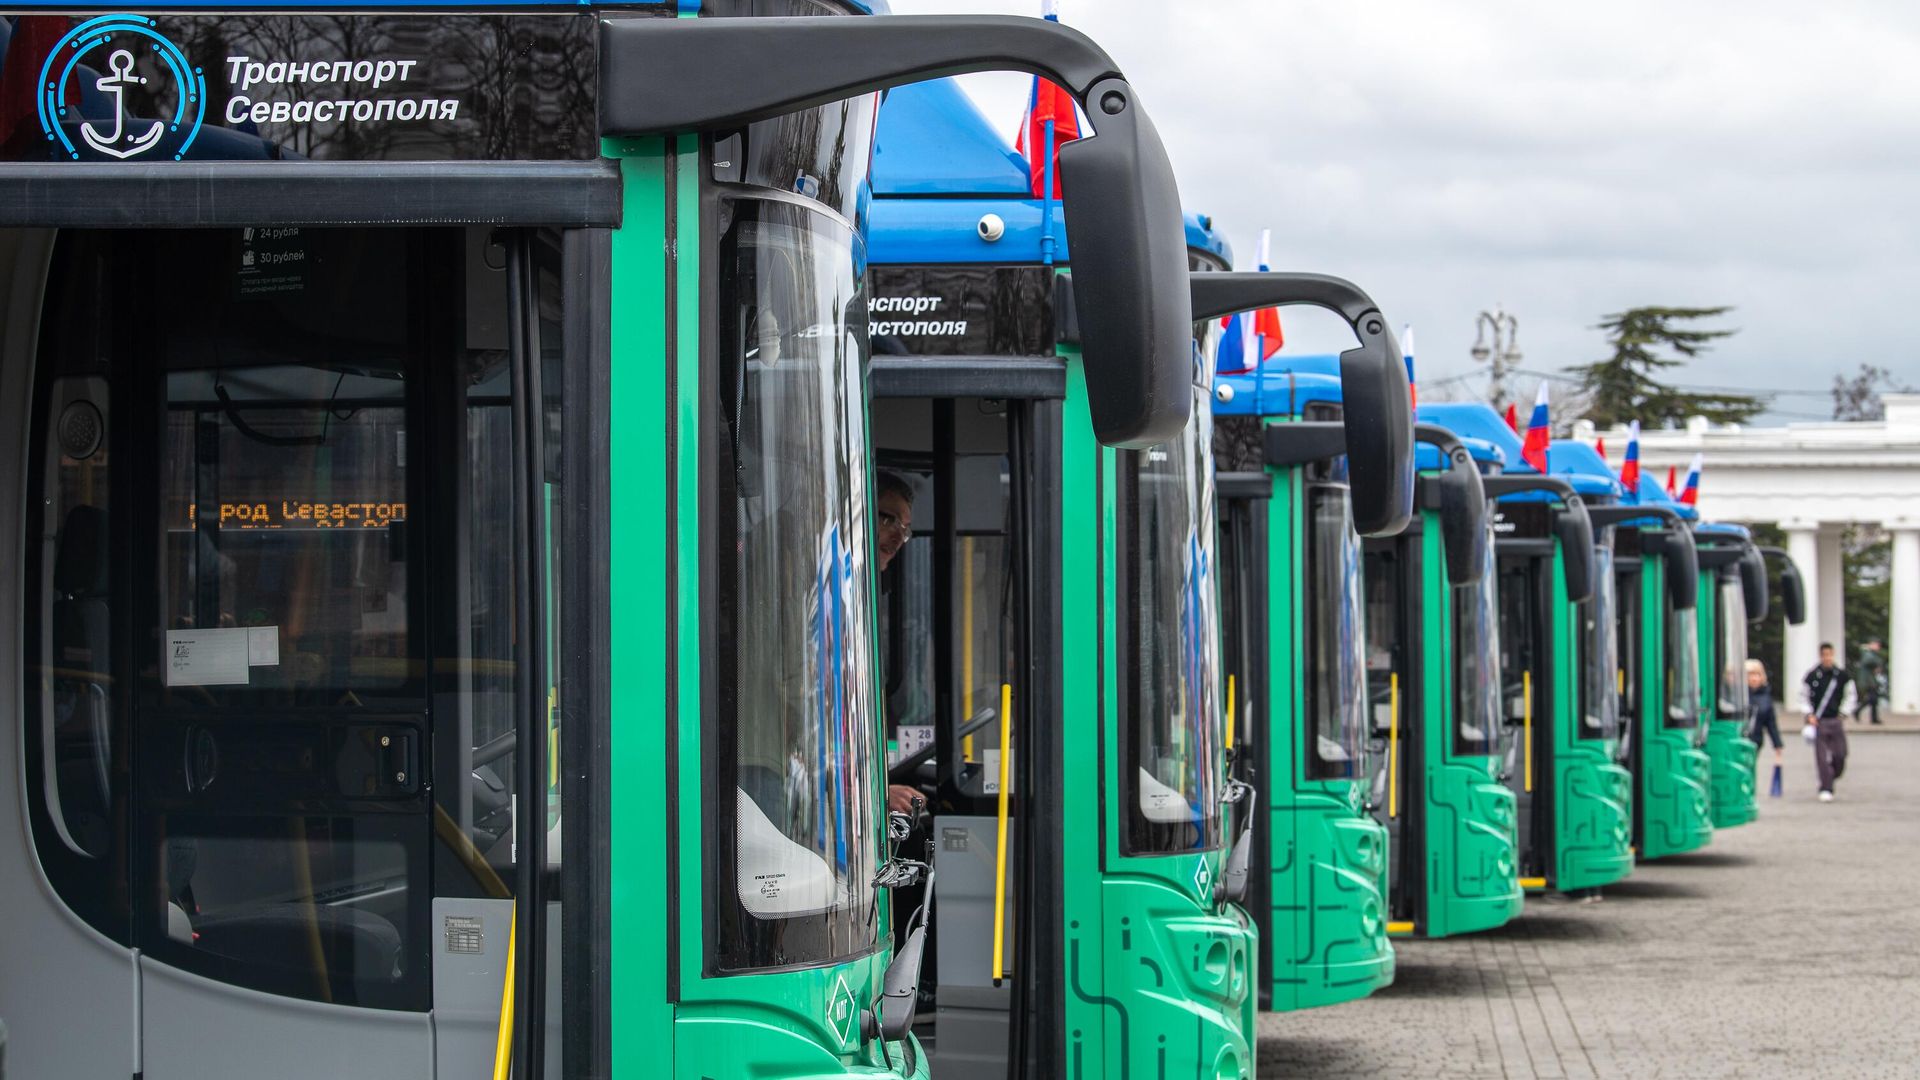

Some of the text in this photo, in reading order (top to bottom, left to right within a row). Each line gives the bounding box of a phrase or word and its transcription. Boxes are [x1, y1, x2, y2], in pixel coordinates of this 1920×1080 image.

[226, 56, 417, 91] Транспорт
[225, 95, 460, 124] Севастополя
[260, 226, 299, 240] 24 рубля
[260, 249, 305, 264] 30 рублей
[868, 296, 942, 315] нспорт
[868, 321, 967, 336] астополя
[282, 500, 406, 520] Севастоп
